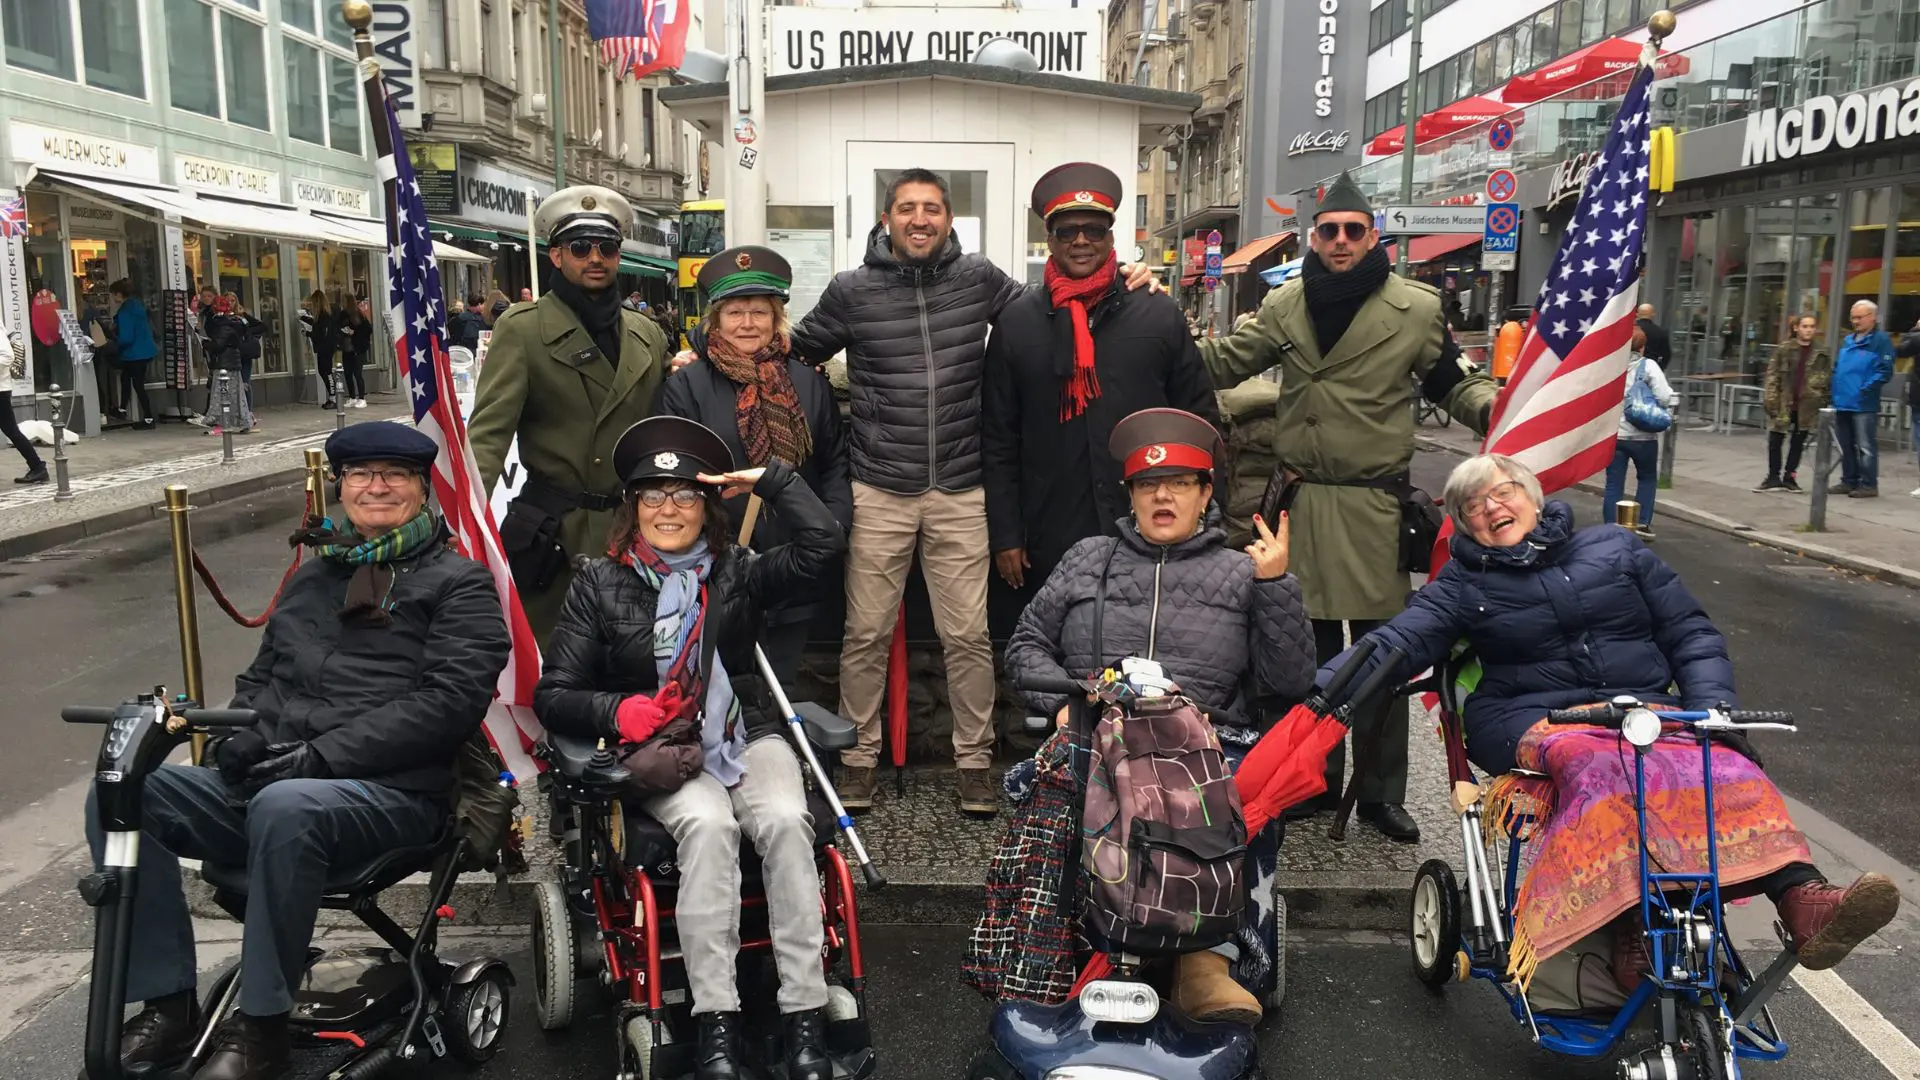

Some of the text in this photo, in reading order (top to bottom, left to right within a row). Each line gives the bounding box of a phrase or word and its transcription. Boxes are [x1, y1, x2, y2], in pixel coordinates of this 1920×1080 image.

[787, 29, 824, 70] US
[839, 30, 914, 67] ARMY
[1741, 78, 1920, 167] McDona
[43, 136, 127, 169] MAUERMUSEUM
[184, 161, 269, 194] CHECKPOINT CHARLIE
[298, 183, 361, 210] CHECKPOINT CHARLIE
[467, 177, 527, 216] CHECKPOINT
[1411, 214, 1485, 225] Jüdisches Museum
[1486, 237, 1514, 249] TAXI
